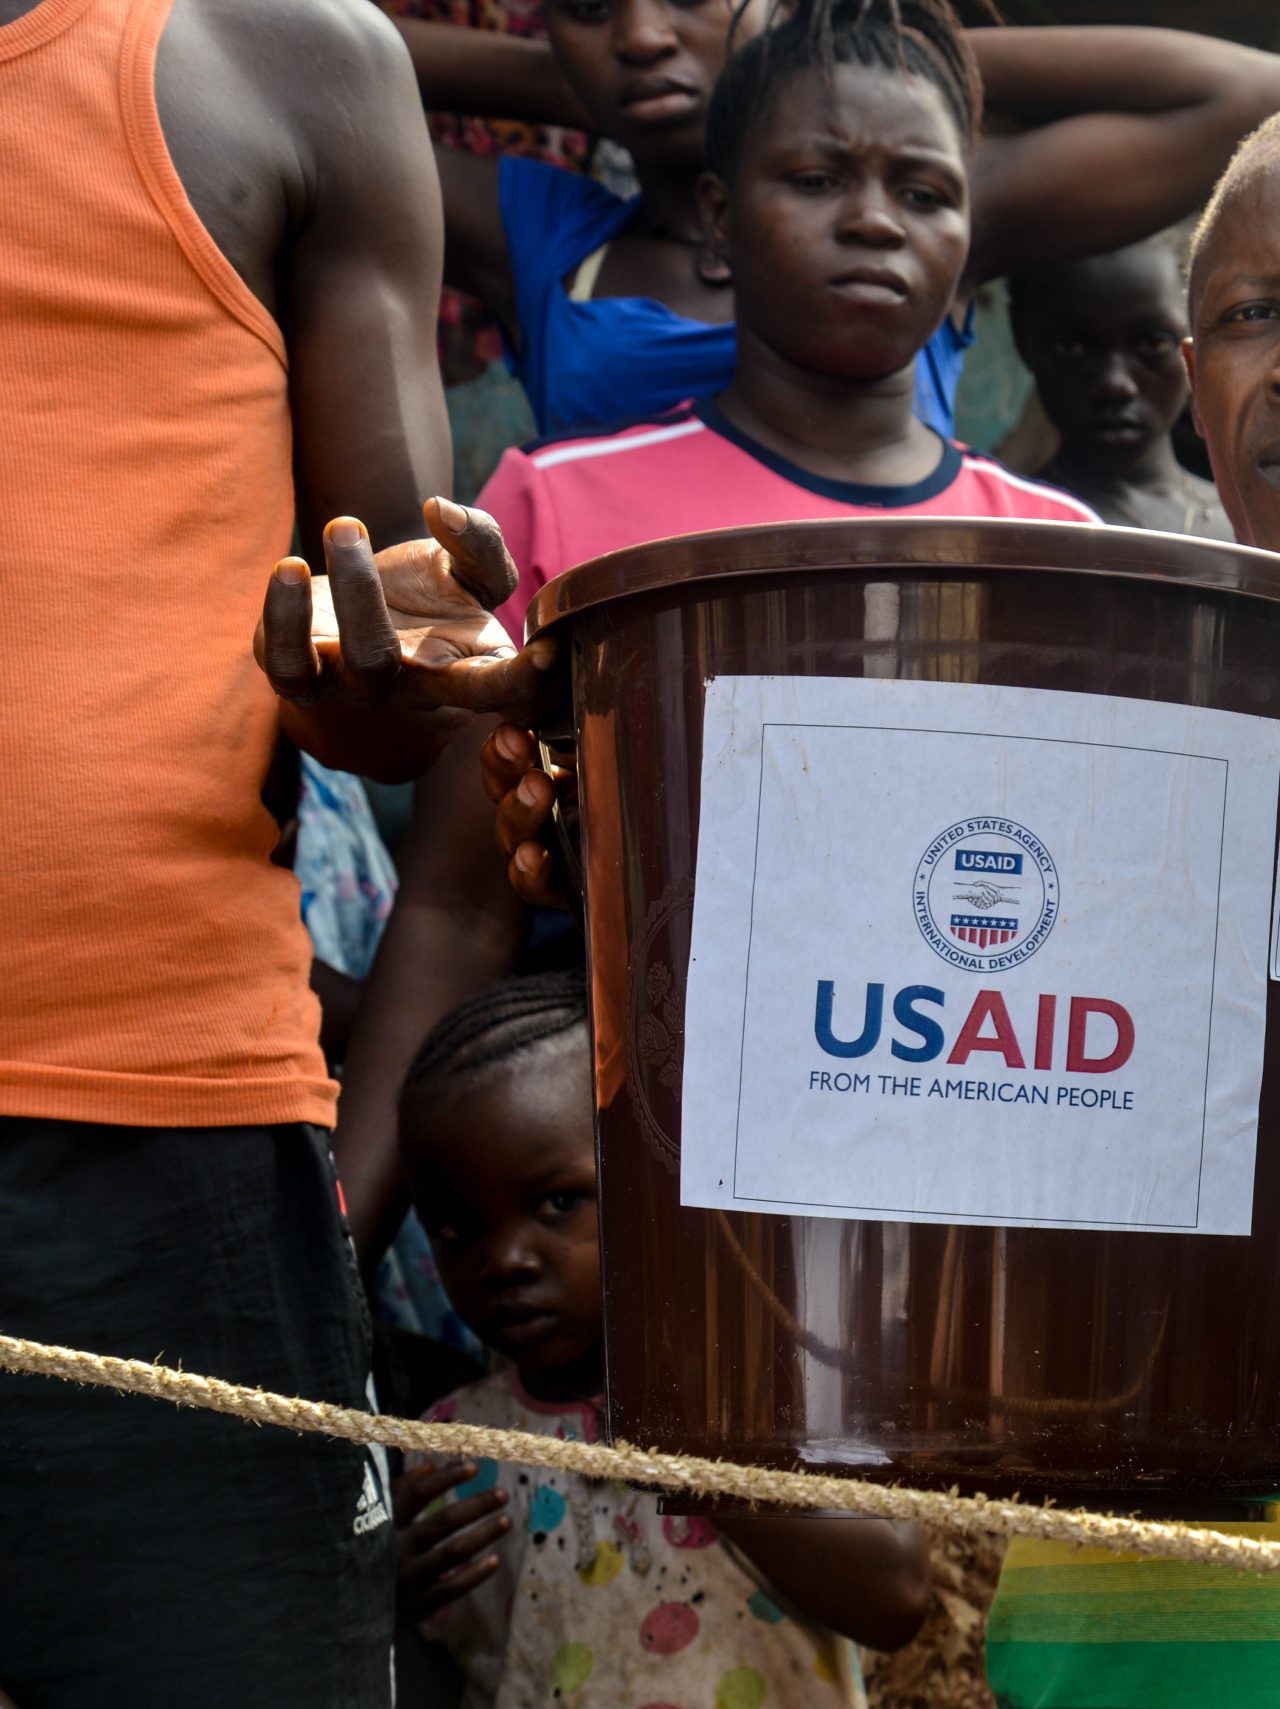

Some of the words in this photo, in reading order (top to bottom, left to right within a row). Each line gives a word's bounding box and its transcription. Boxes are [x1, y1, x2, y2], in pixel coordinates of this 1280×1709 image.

[924, 826, 965, 865] UNITED
[967, 820, 1014, 834] STATES
[1013, 829, 1053, 873] AGENCY
[961, 853, 1016, 870] USAID
[916, 891, 985, 969] INTERNATIONAL
[989, 899, 1056, 969] DEVELOPMENT
[813, 979, 1136, 1074] USAID
[809, 1071, 871, 1093] FROM
[878, 1075, 921, 1097] THE
[928, 1078, 1049, 1106] AMERICAN
[1056, 1086, 1134, 1111] PEOPLE
